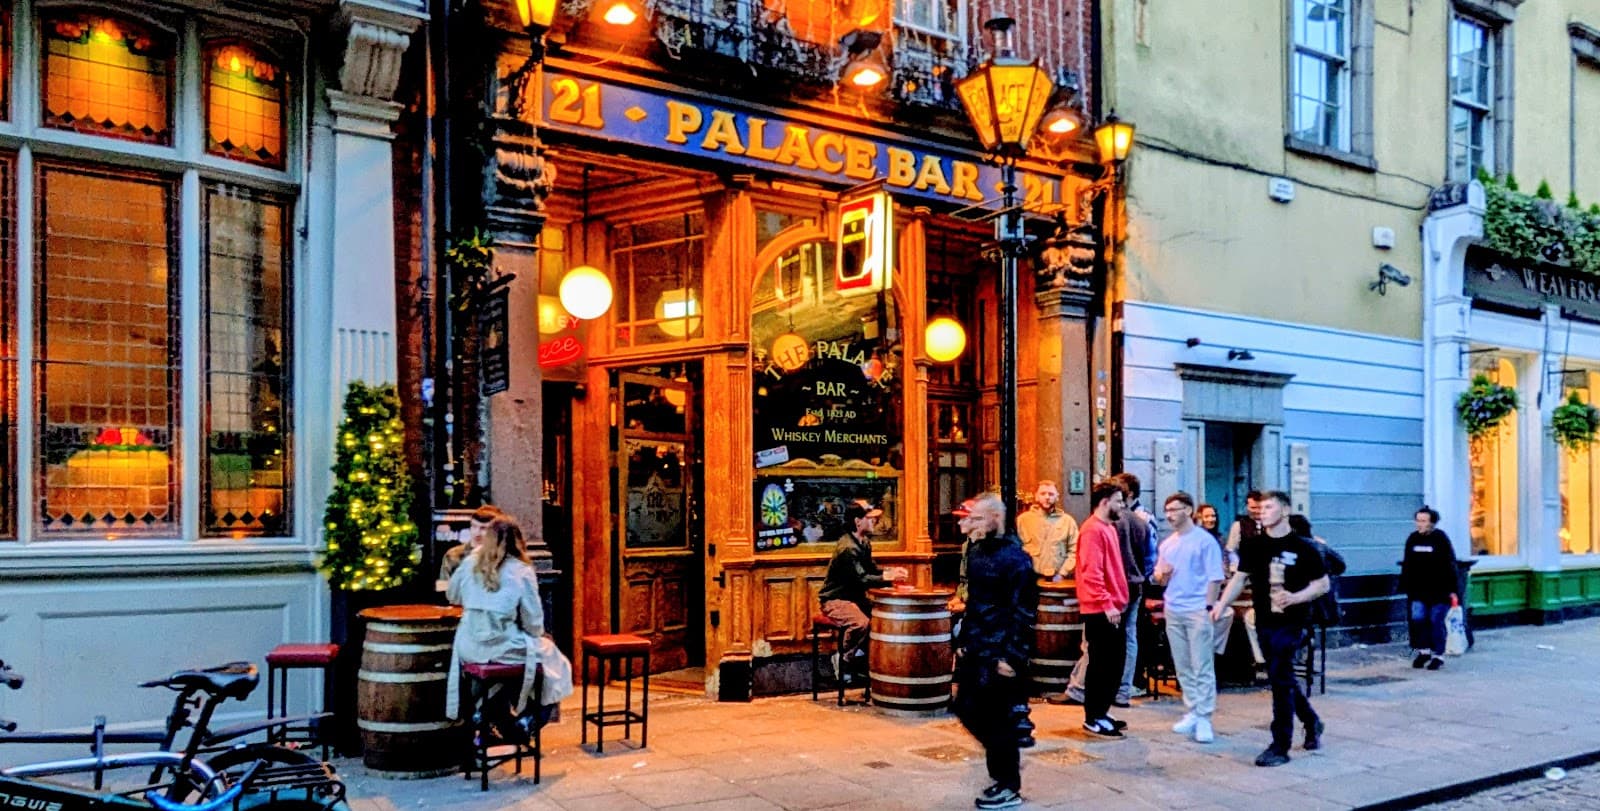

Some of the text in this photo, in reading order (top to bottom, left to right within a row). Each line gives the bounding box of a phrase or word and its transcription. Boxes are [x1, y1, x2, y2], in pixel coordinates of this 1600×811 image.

[549, 78, 1062, 213] 21 PALACE BAR 21
[1521, 266, 1596, 304] WEAVERS
[763, 340, 894, 390] THE PALAE
[816, 381, 847, 397] BAR
[845, 410, 857, 419] AD
